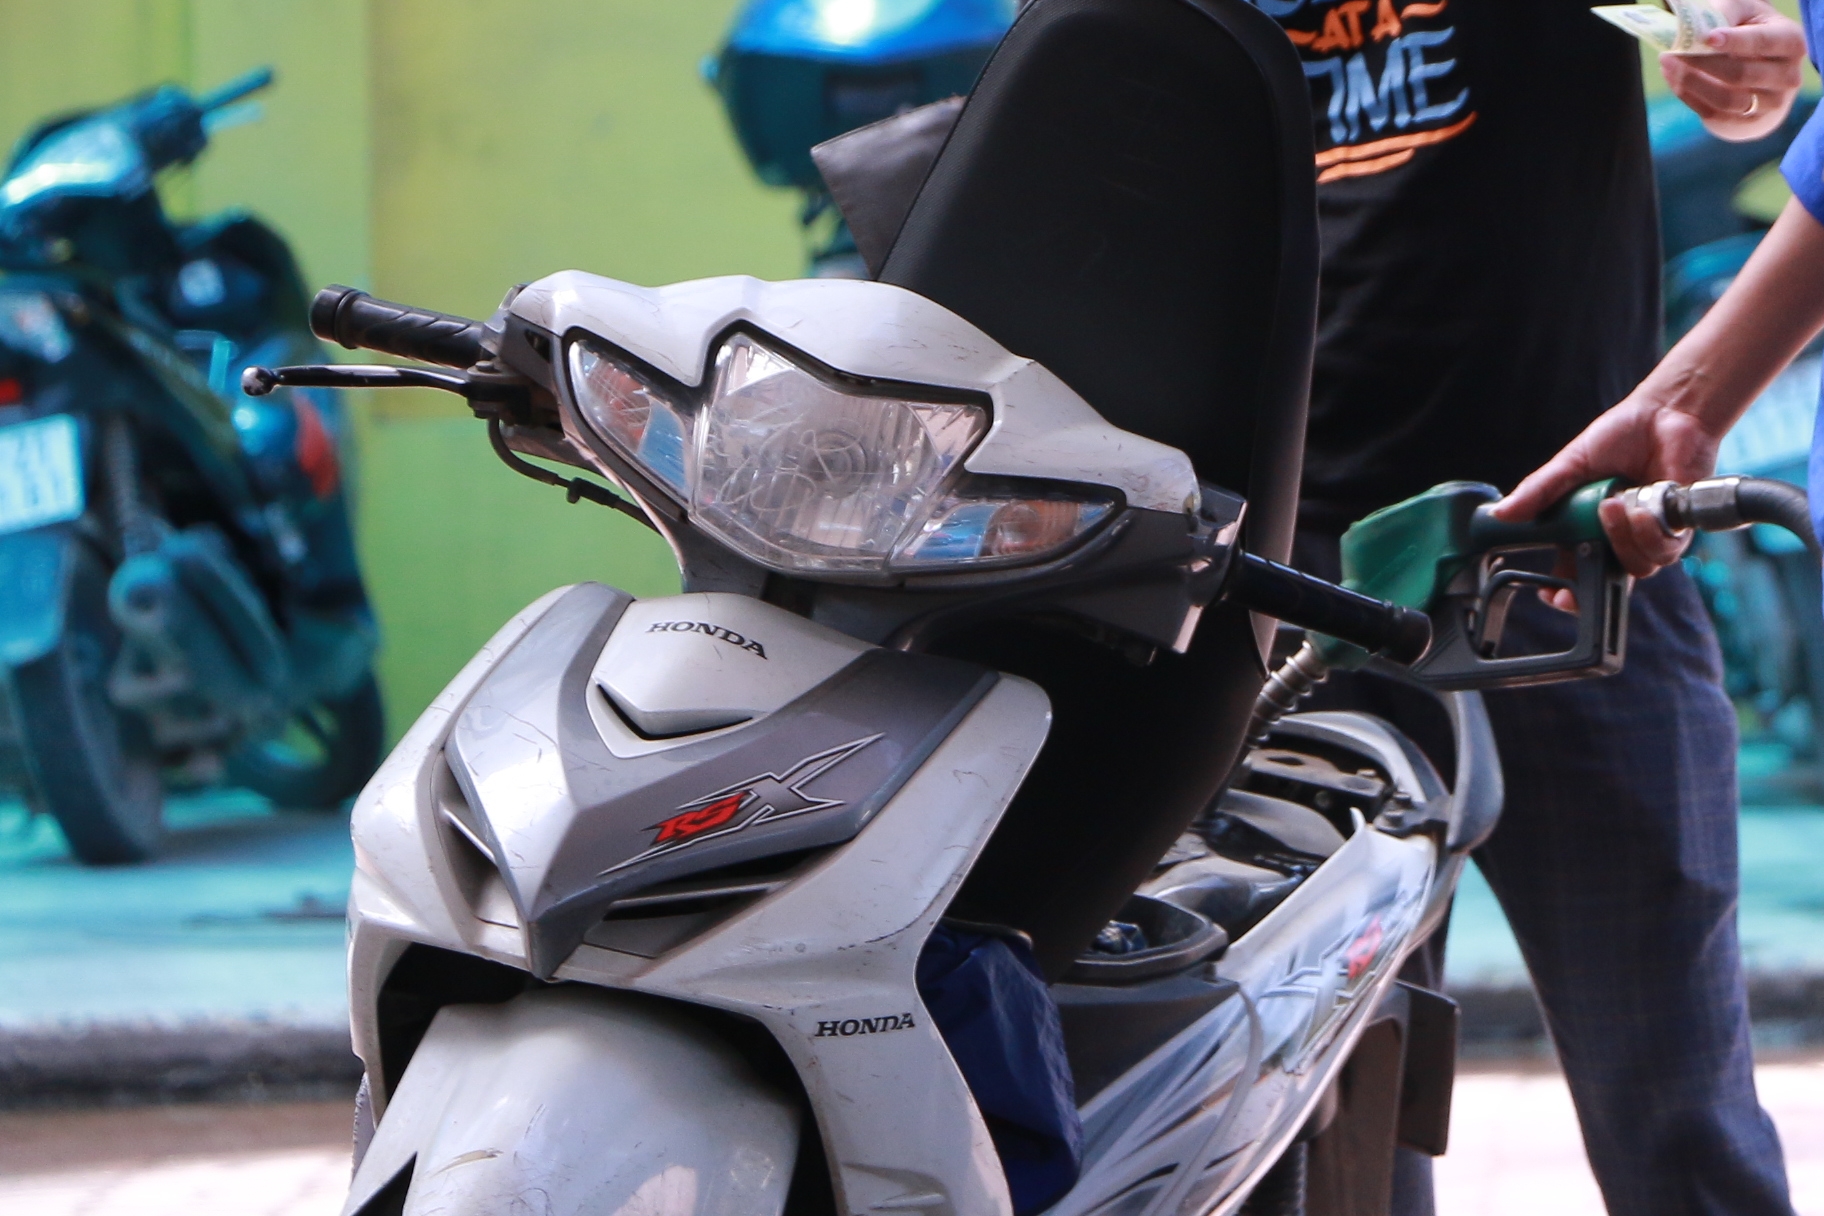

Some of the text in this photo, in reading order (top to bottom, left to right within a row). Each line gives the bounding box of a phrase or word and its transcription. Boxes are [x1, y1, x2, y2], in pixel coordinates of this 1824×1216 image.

[1301, 25, 1470, 145] IME
[645, 621, 768, 660] HONDA
[814, 1012, 916, 1037] HONDA
